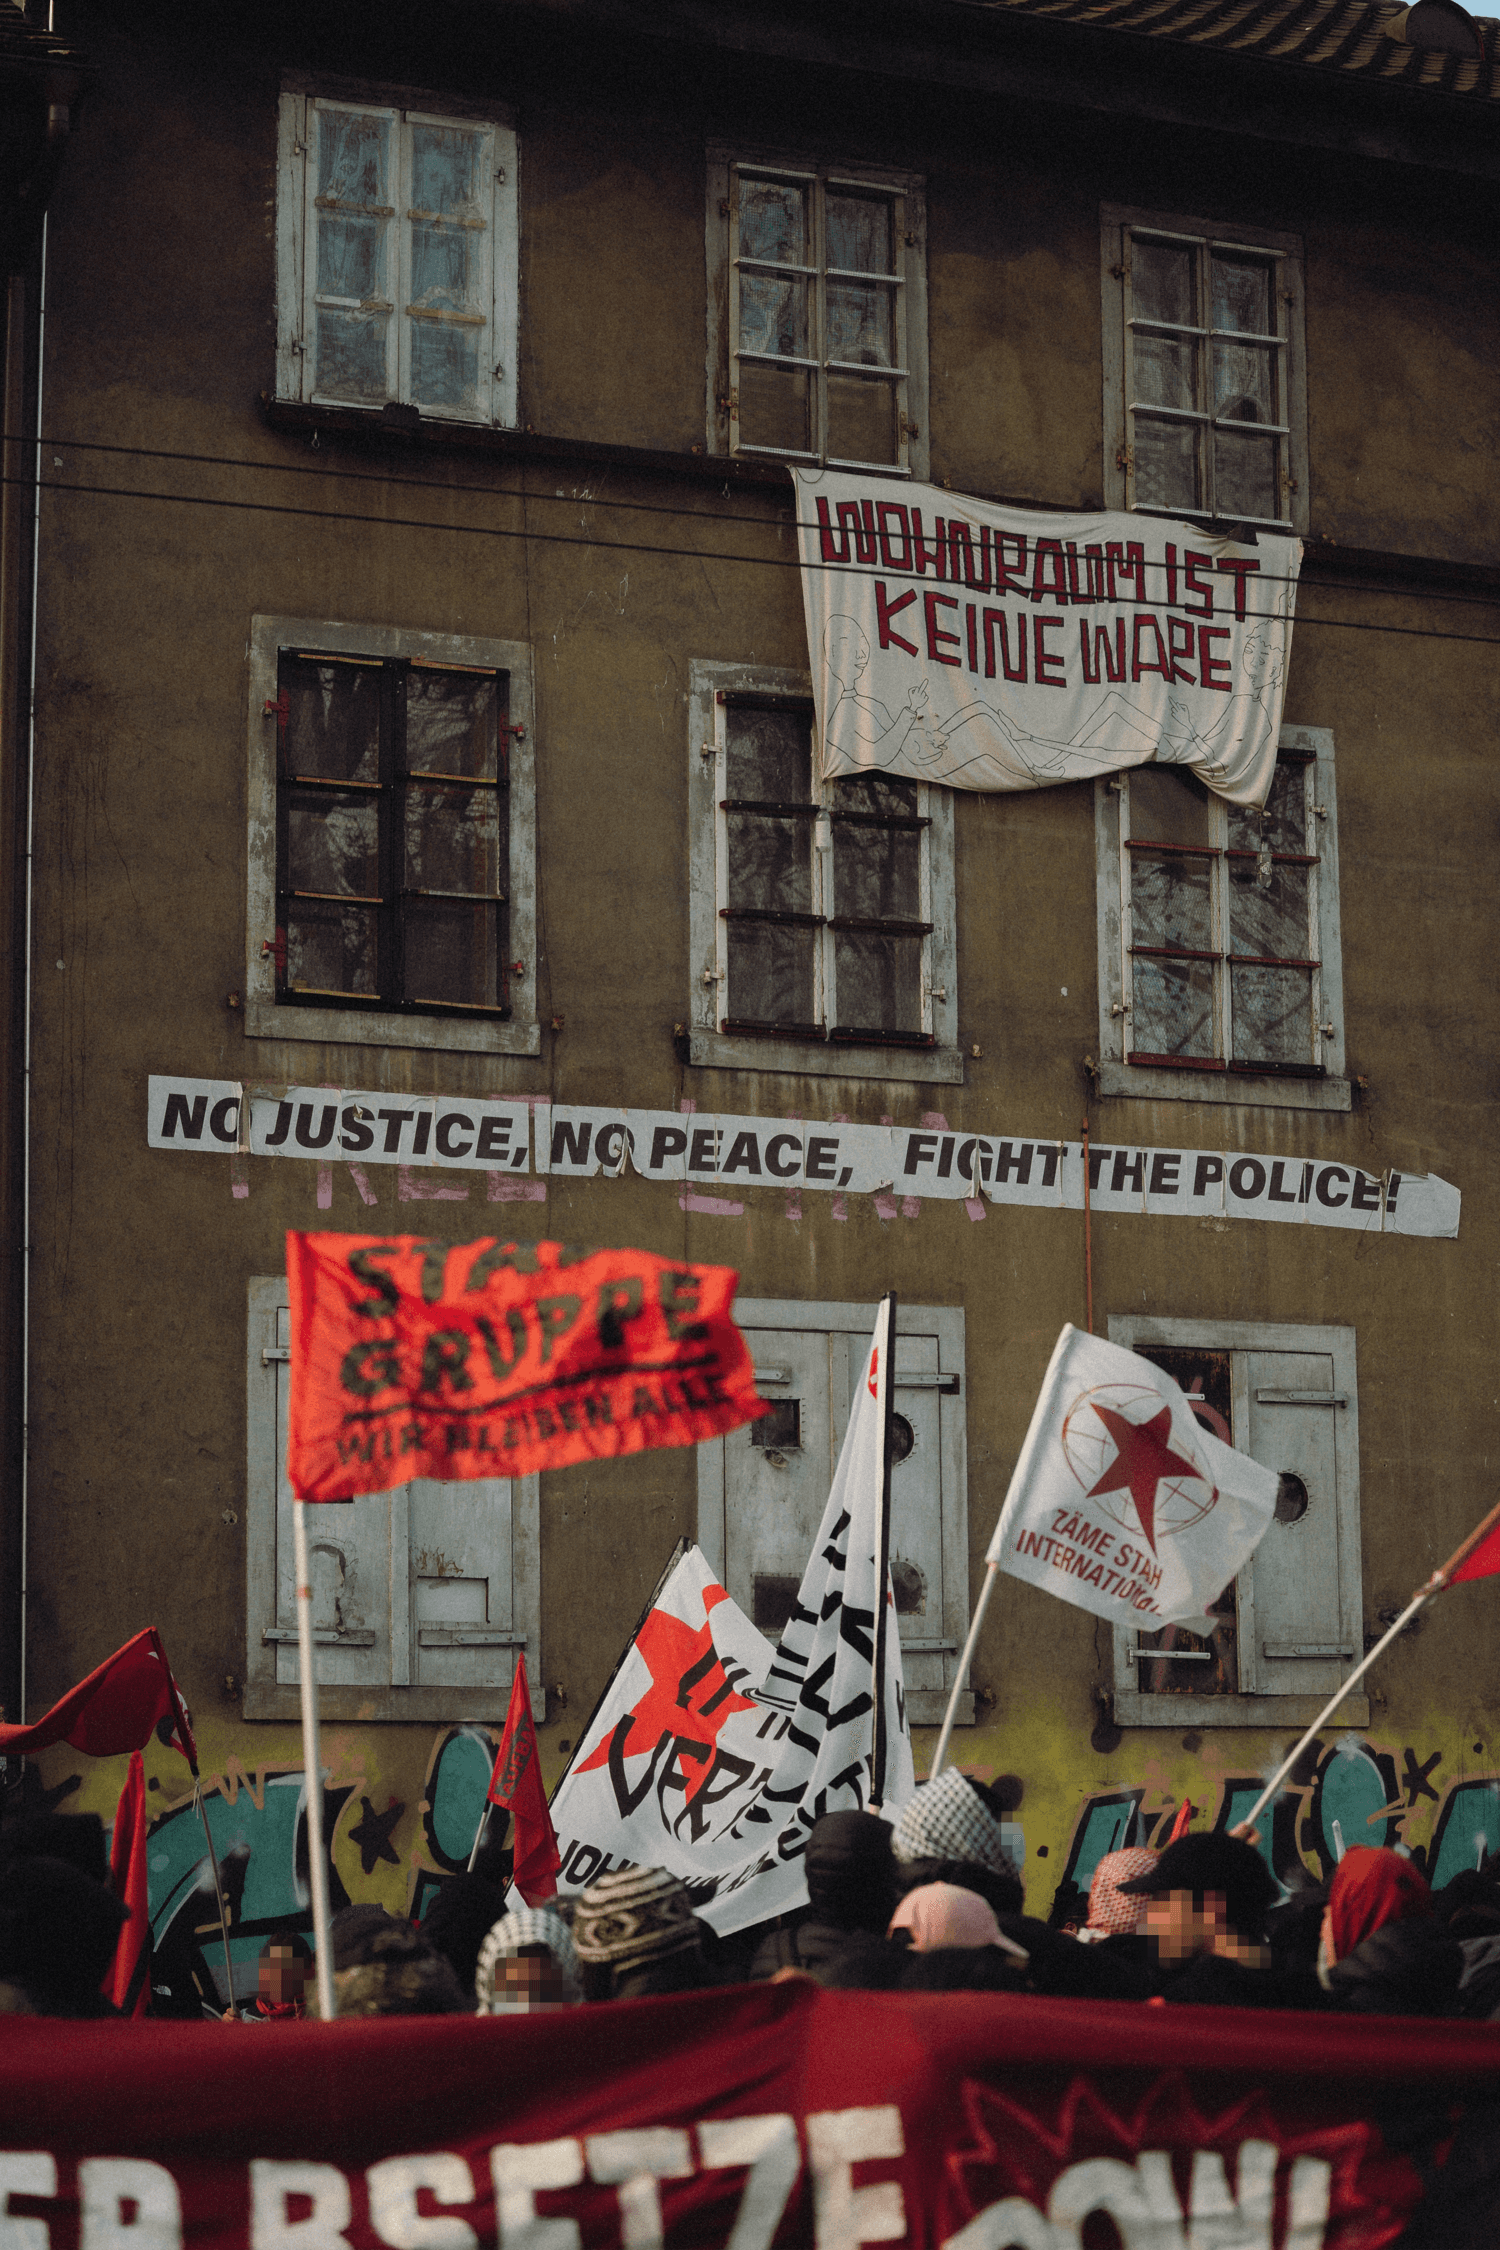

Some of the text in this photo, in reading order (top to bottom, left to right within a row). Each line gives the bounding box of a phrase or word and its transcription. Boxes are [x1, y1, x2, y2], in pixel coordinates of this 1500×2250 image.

[815, 496, 1260, 622] WOHNRAUM IST
[875, 580, 1232, 692] KEINE WARE
[265, 1101, 529, 1167] JUSTICE,
[551, 1121, 635, 1168] NO
[650, 1126, 854, 1187] PEACE,
[904, 1134, 1069, 1187] FIGHT
[1081, 1148, 1182, 1195] THE
[1193, 1155, 1402, 1214] POLICE!
[337, 1420, 424, 1465] WIR
[446, 1392, 613, 1453] BLEIBEN
[1051, 1508, 1164, 1591] ZÄME STAH
